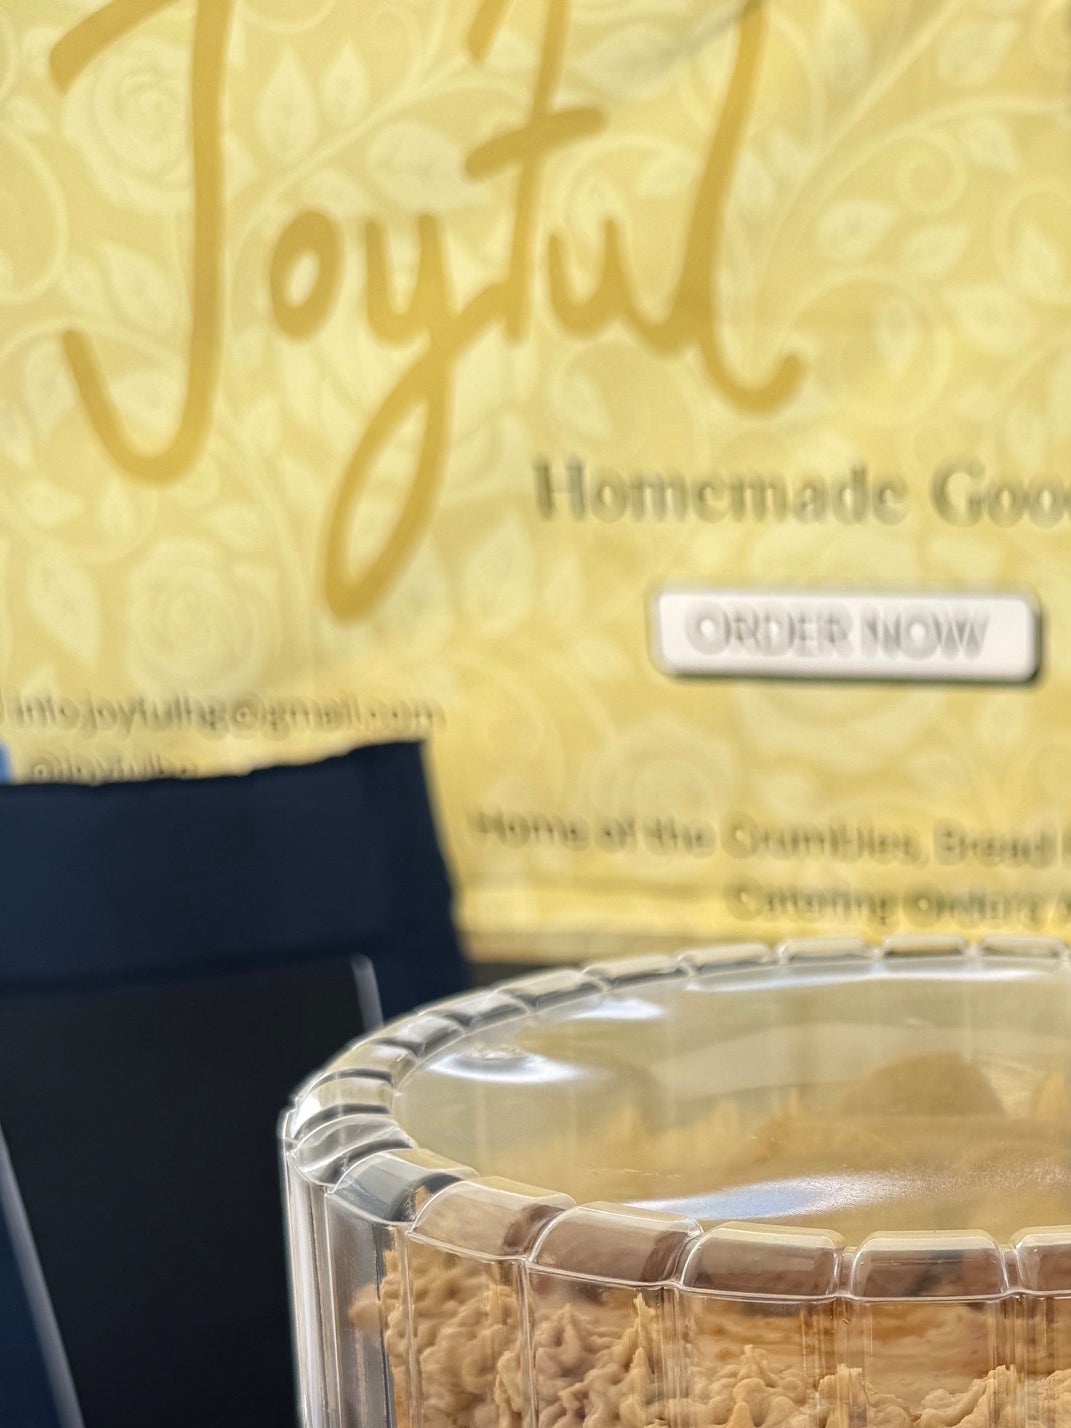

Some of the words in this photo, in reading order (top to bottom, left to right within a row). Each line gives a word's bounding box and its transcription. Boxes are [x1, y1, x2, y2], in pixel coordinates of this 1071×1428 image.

[50, 0, 806, 622] Joyful
[534, 455, 909, 524] Homemade
[684, 603, 850, 657] ORDER
[861, 605, 991, 661] NOW
[466, 805, 590, 850] Home
[594, 808, 637, 853] of
[643, 810, 717, 858] the
[933, 817, 1057, 868] Bread
[724, 873, 900, 934] Catering
